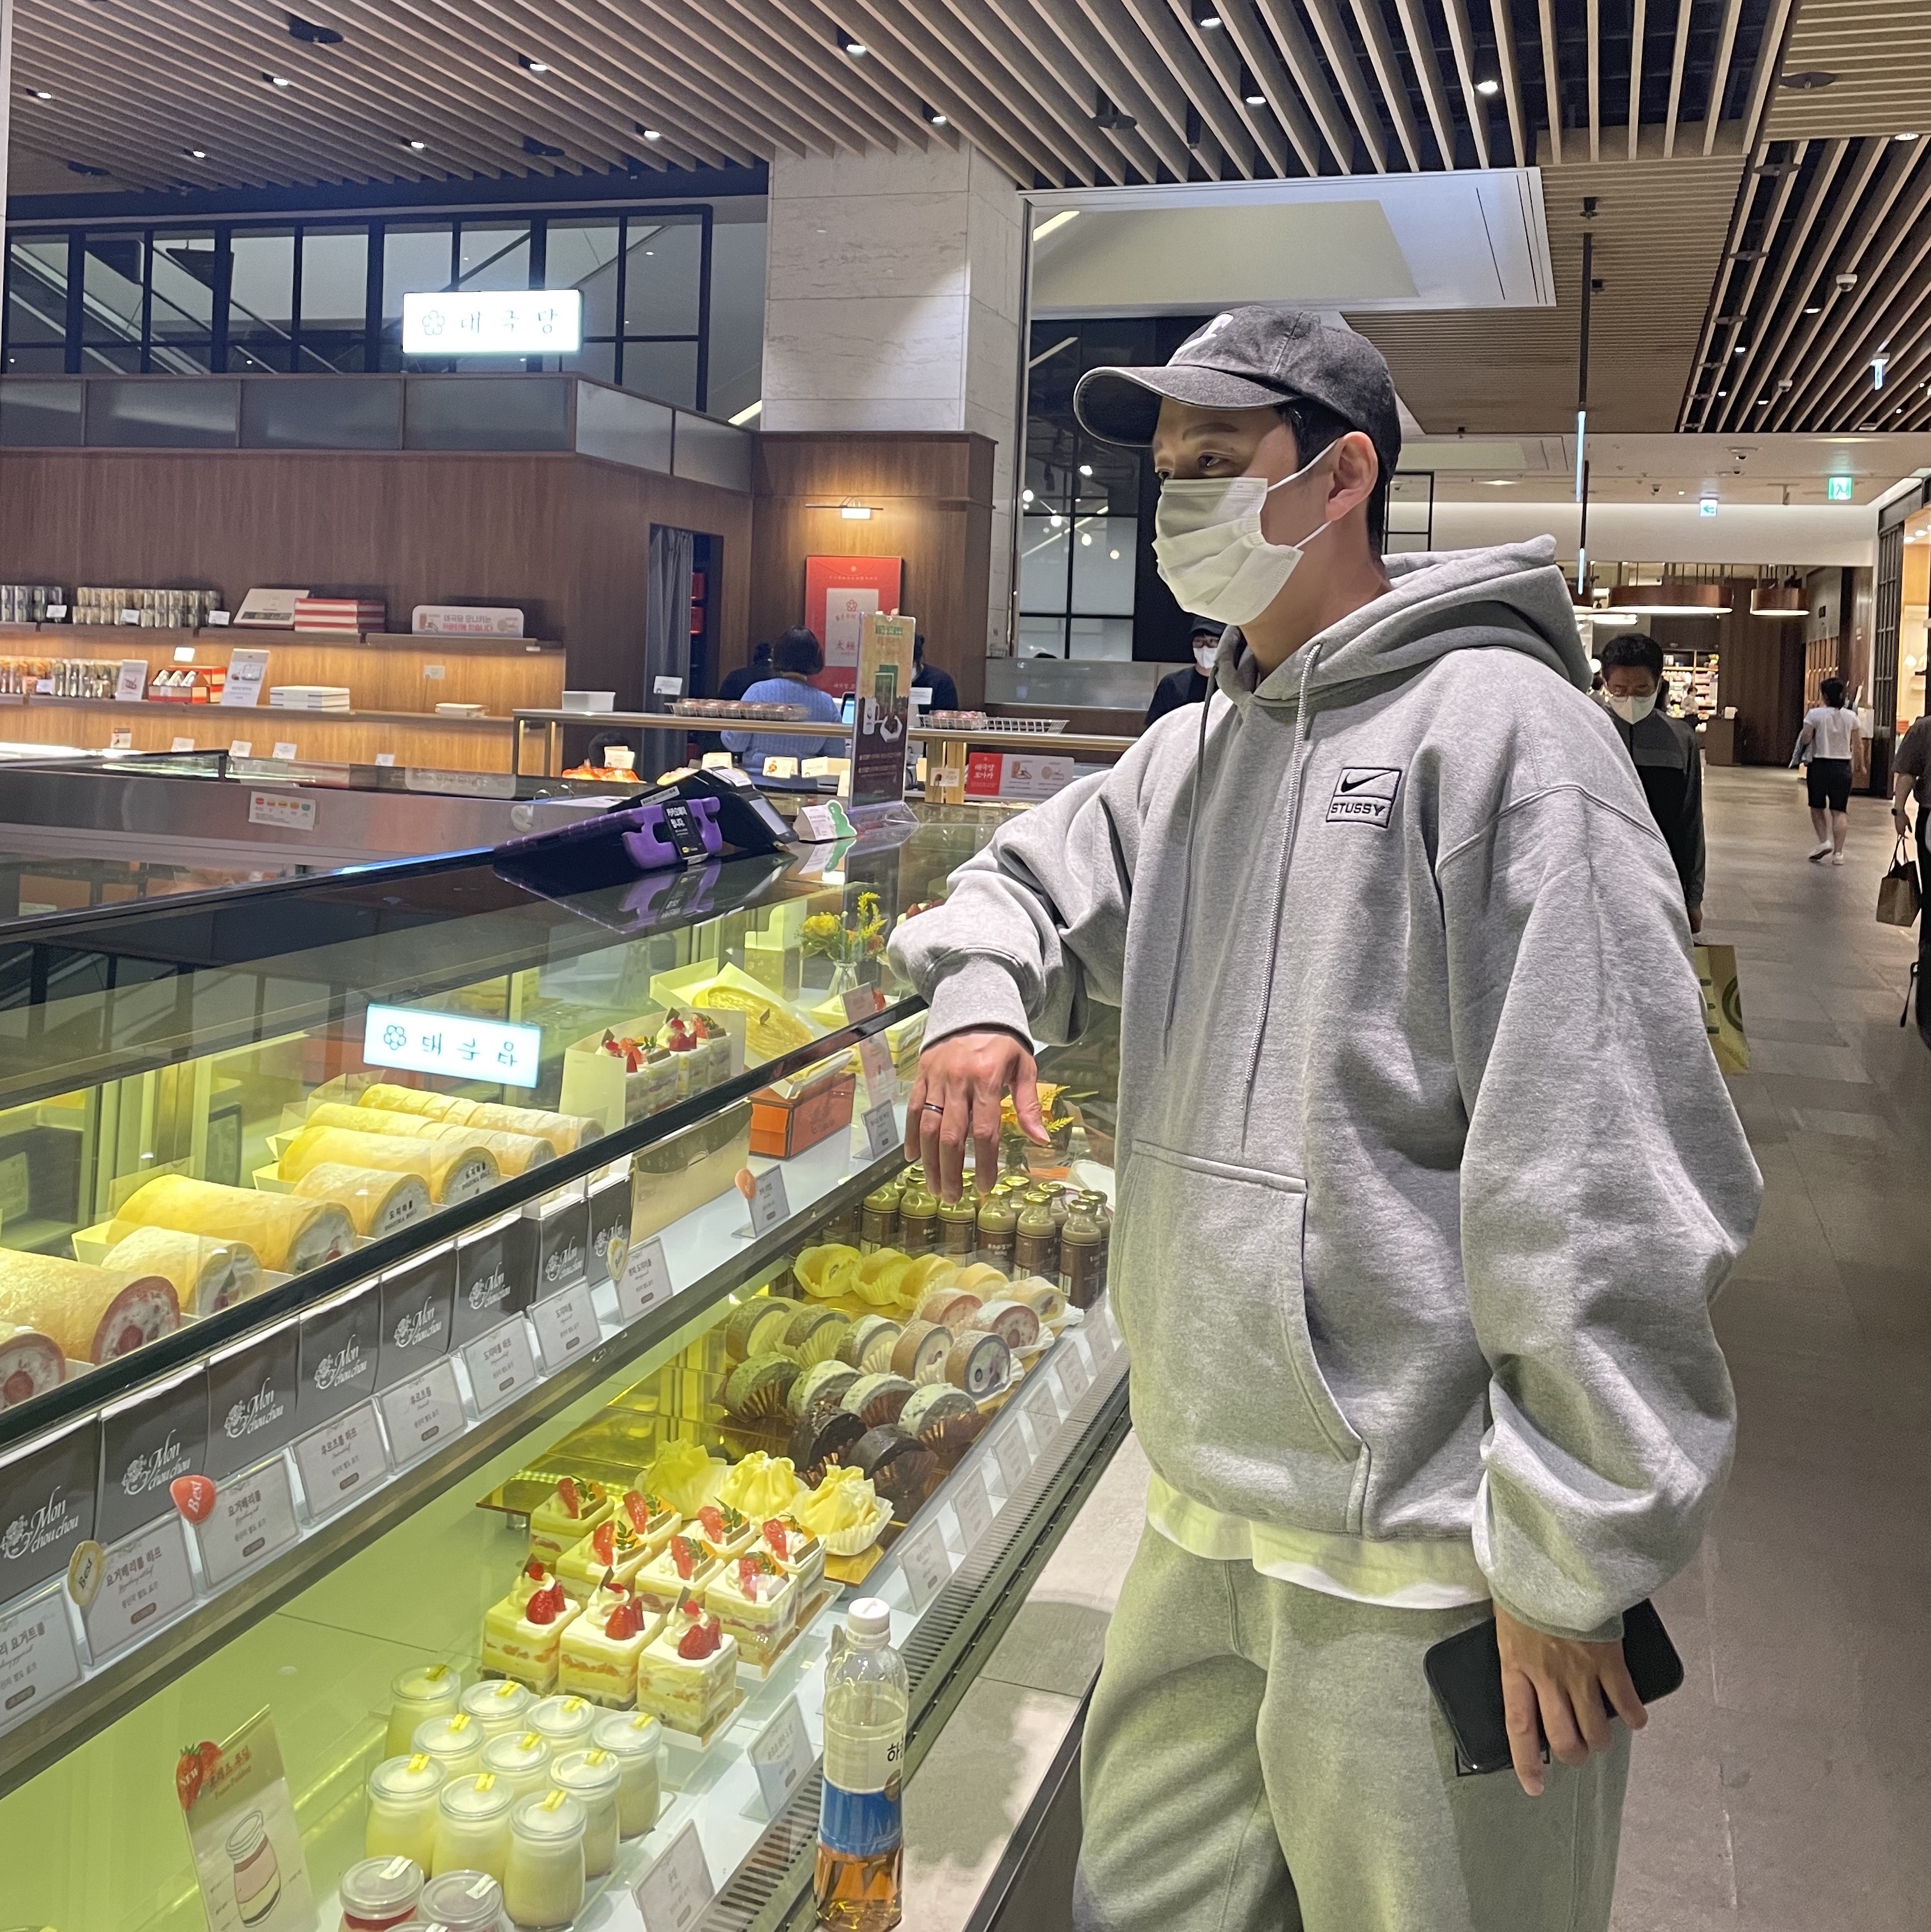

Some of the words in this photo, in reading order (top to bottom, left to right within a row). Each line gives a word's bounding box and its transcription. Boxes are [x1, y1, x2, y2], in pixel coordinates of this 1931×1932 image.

[1331, 802, 1385, 816] STUSSY
[412, 1296, 434, 1330] Mon
[334, 1334, 359, 1371] Mon
[247, 1377, 274, 1417] Mon
[148, 1429, 180, 1474] Mon
[30, 1486, 66, 1536] Mon
[188, 1480, 202, 1513] Best
[146, 1546, 162, 1562] 하프
[79, 1557, 93, 1589] Best
